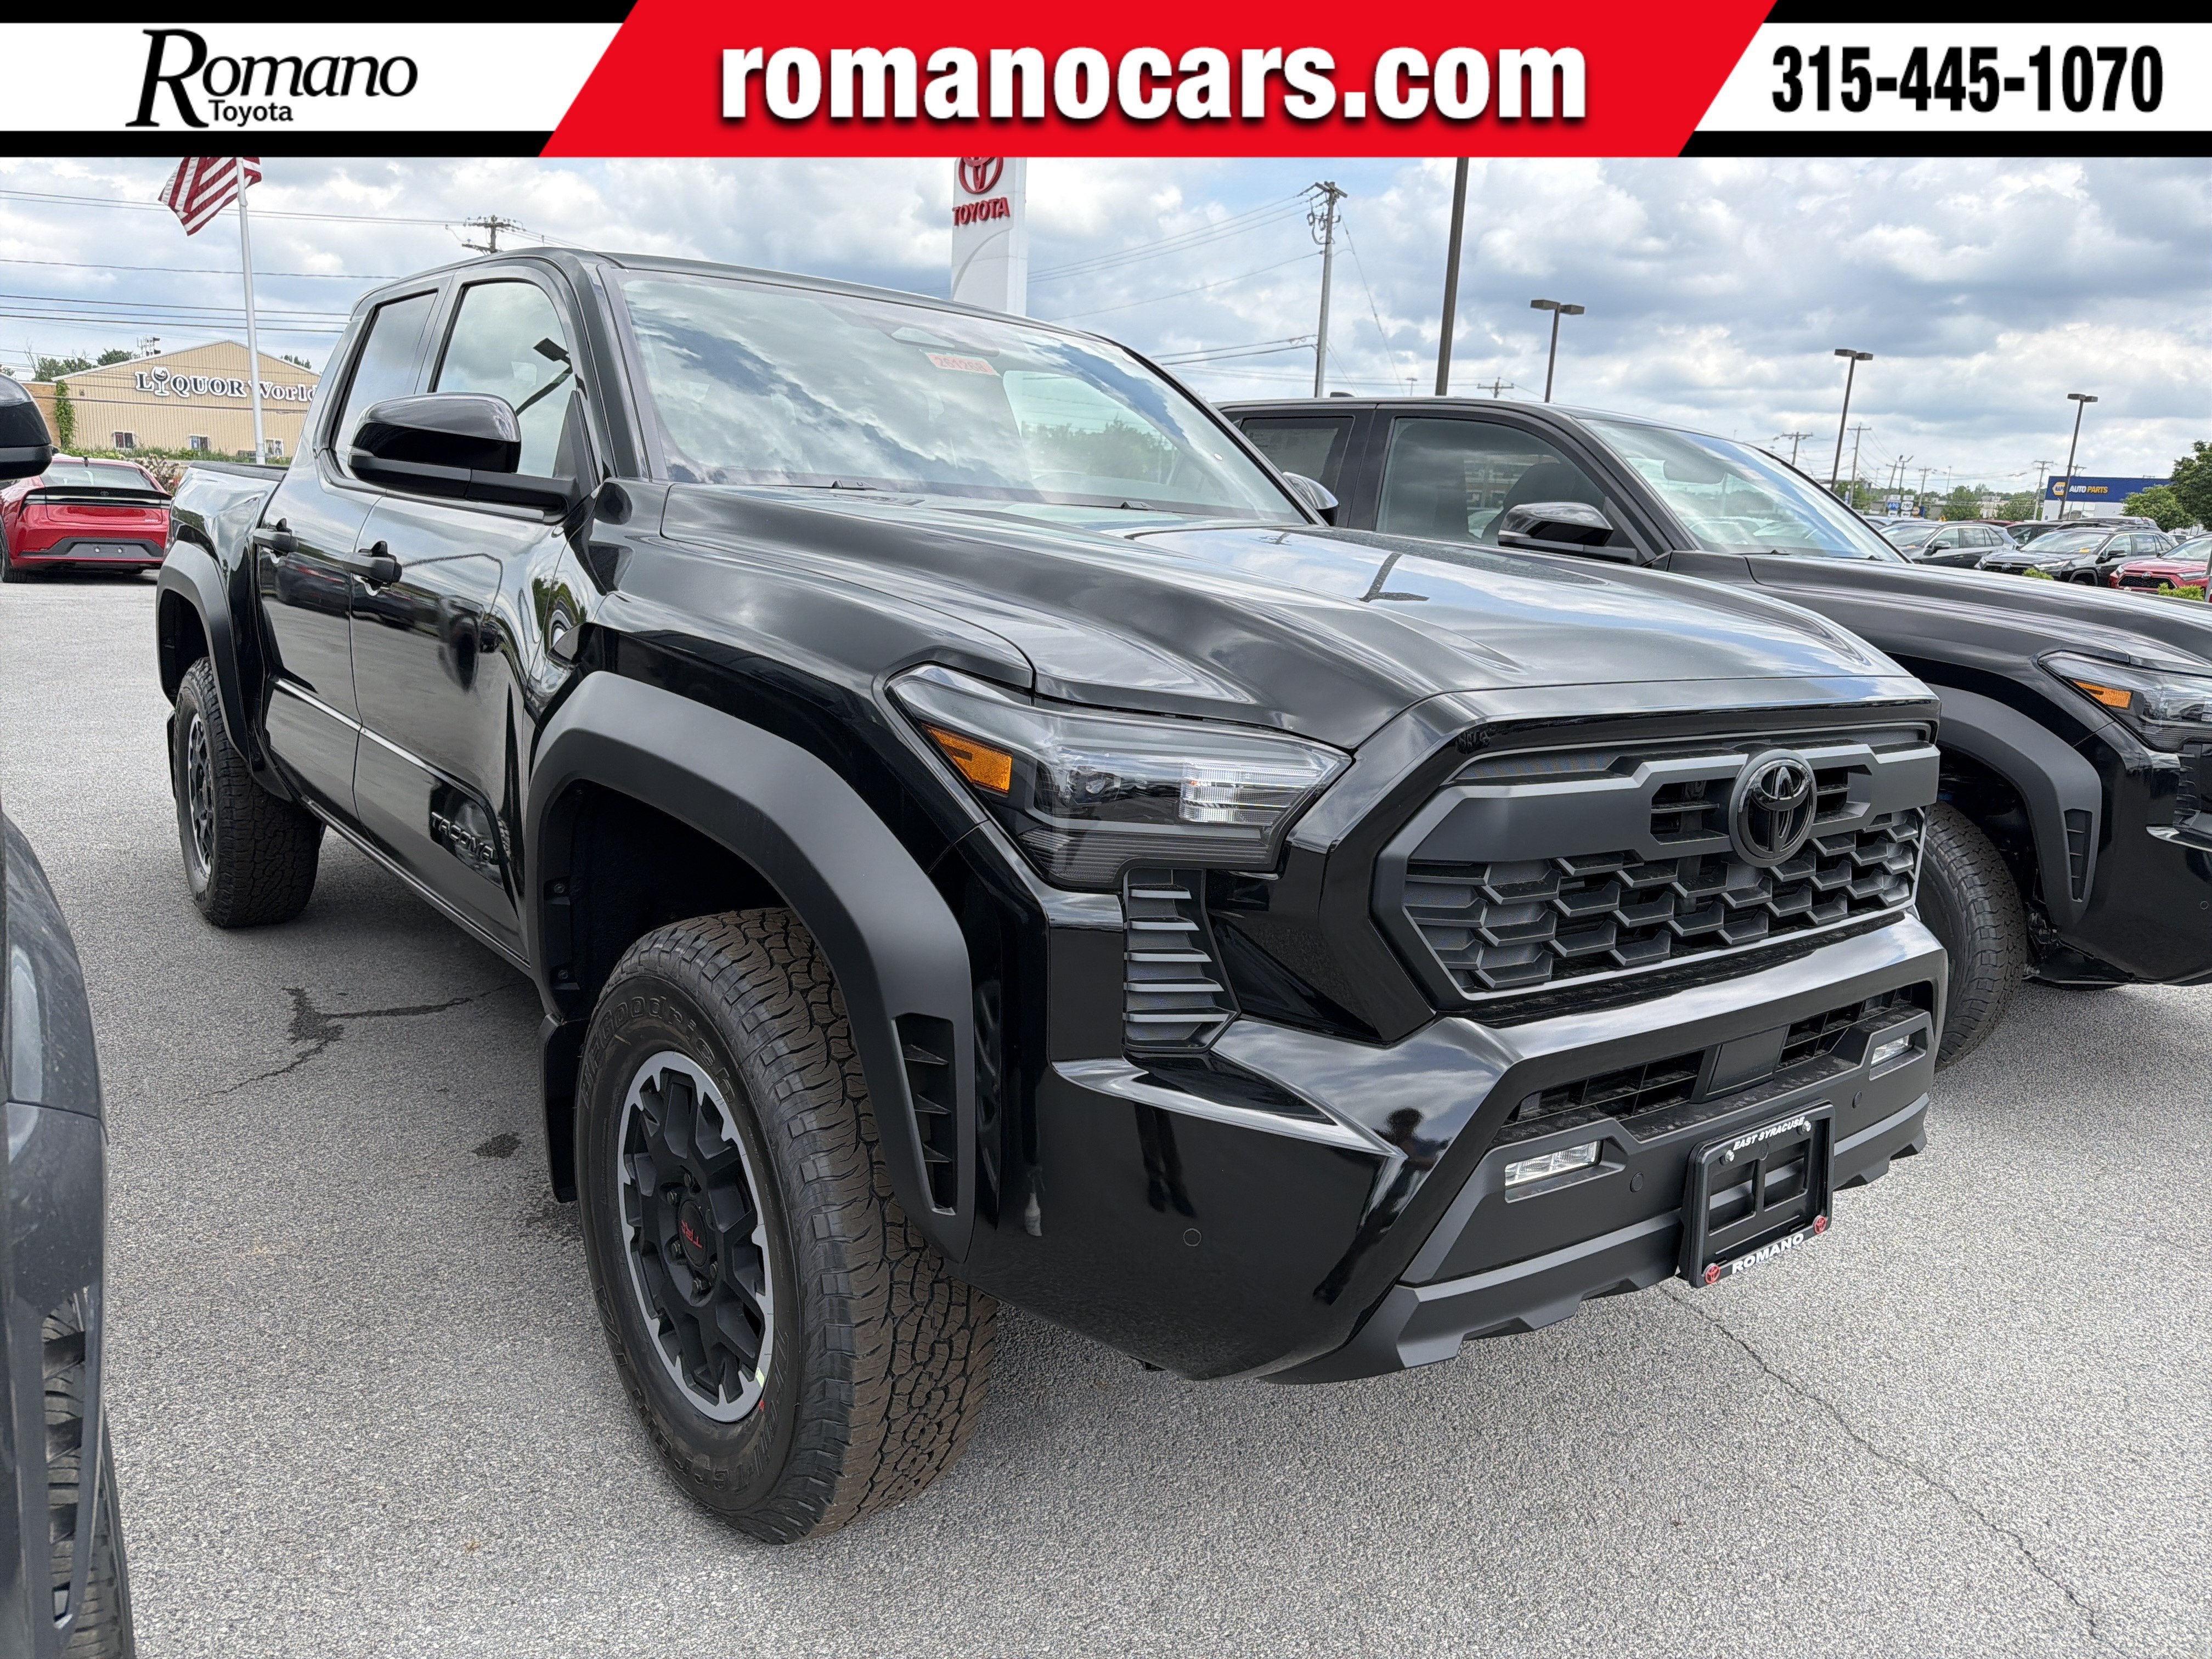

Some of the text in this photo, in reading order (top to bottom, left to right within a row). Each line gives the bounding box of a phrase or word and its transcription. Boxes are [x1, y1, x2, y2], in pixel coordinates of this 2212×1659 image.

[952, 197, 1011, 227] TOYOTA
[2069, 485, 2087, 493] AUTO
[2086, 485, 2109, 494] PARTS
[431, 811, 494, 862] TACOMA
[1732, 1116, 1805, 1151] EAST SYRACUSE
[680, 1220, 703, 1249] TRD
[1731, 1233, 1804, 1274] ROMANO
